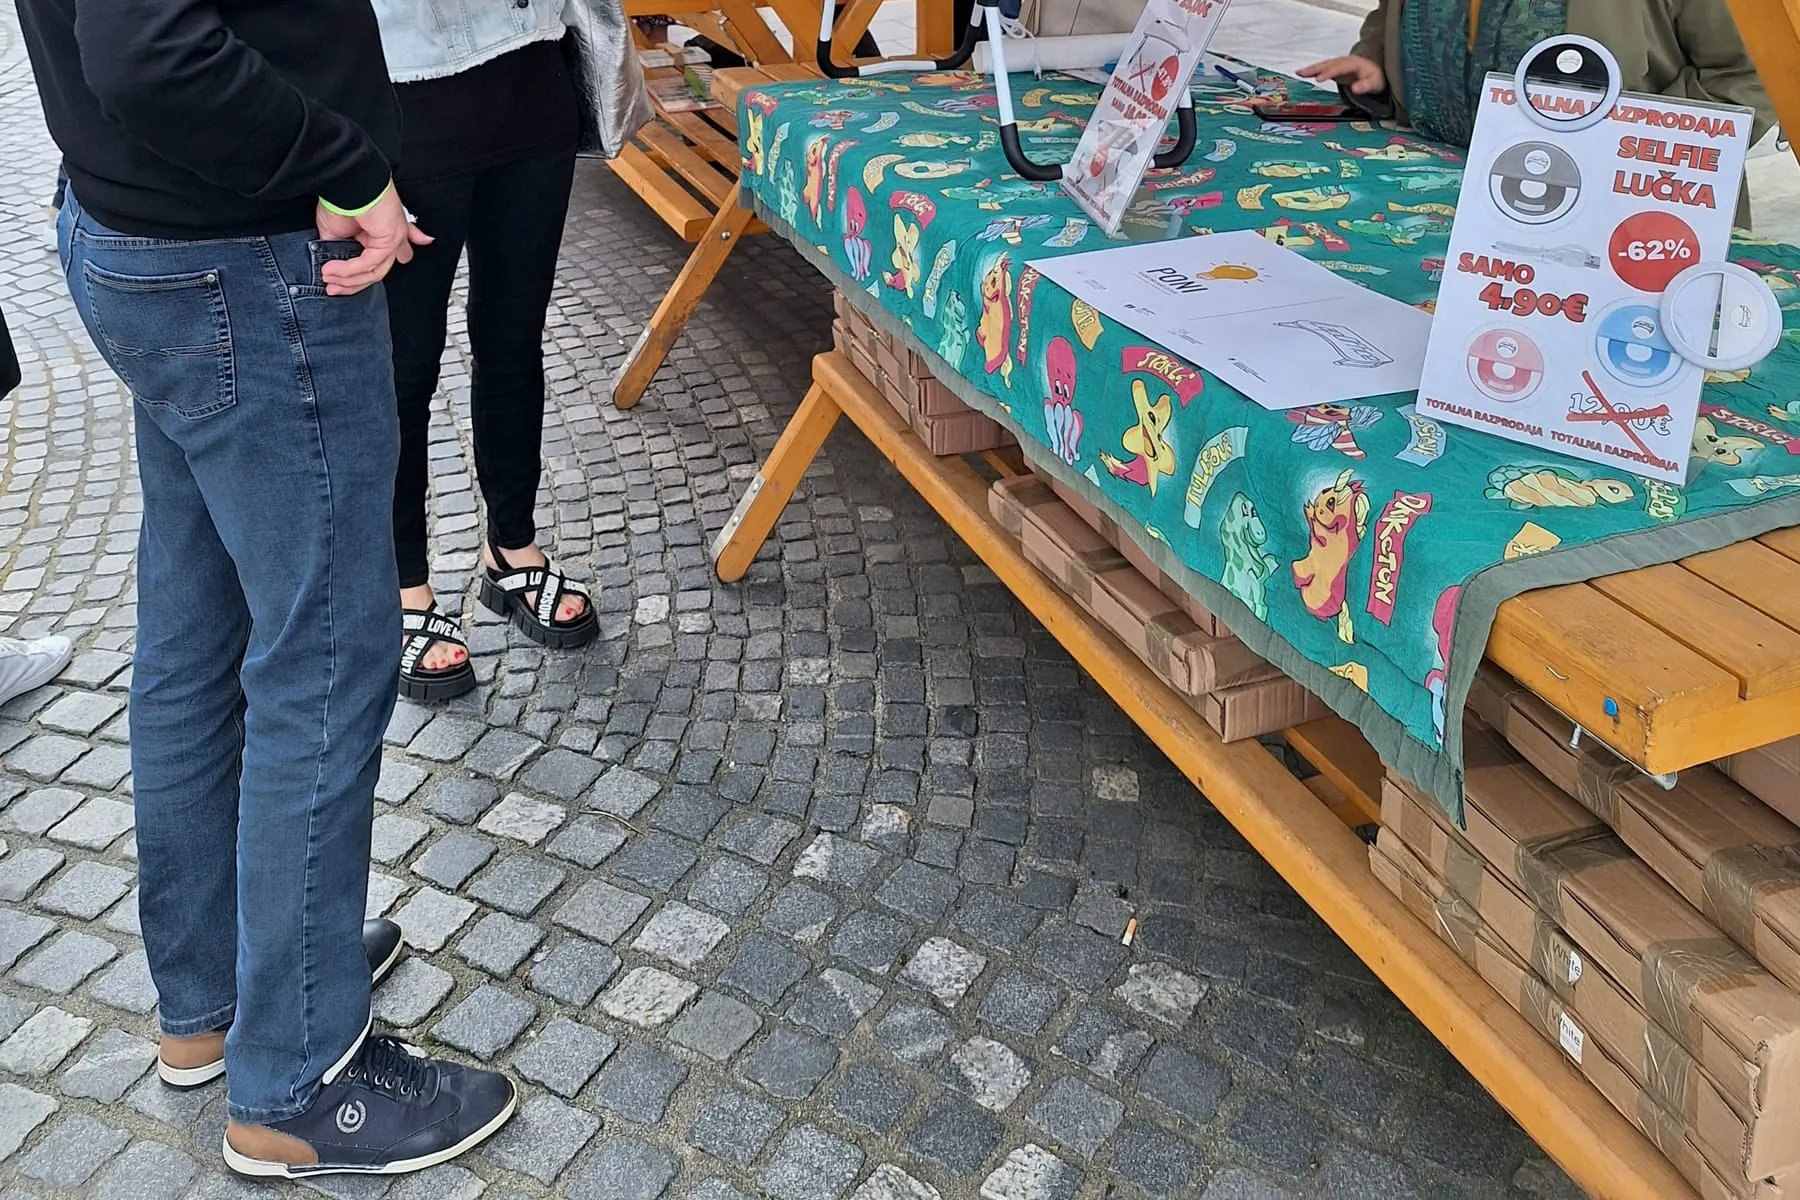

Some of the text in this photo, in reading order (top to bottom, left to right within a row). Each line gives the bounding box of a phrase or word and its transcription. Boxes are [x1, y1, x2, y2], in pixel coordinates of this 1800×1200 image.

[1616, 135, 1721, 173] SELFIE
[1613, 169, 1717, 209] LUČKA
[1458, 252, 1536, 285] SAMO
[1618, 238, 1692, 262] -62%
[1146, 267, 1208, 294] PONI
[1478, 281, 1590, 324] 4,90€
[1426, 397, 1473, 419] TOTALNA
[1474, 410, 1544, 438] RAZPRODAJA
[1550, 430, 1603, 453] TOTALNA
[1552, 939, 1581, 976] White
[1551, 1007, 1581, 1046] White
